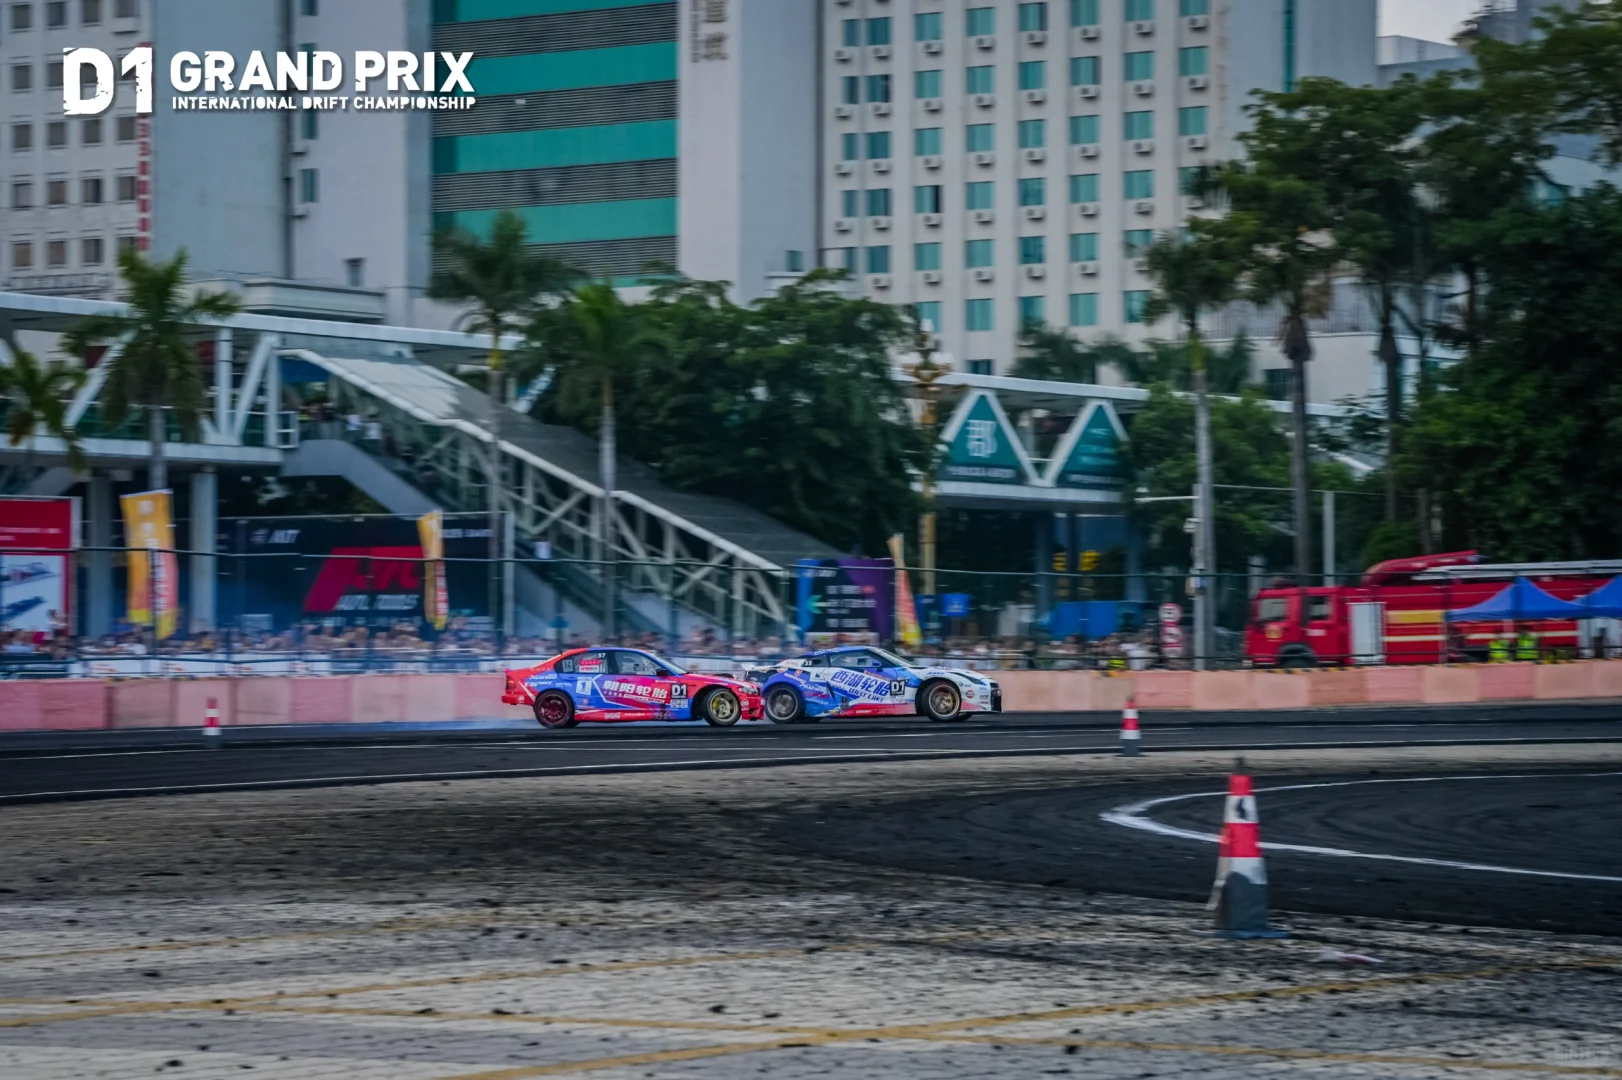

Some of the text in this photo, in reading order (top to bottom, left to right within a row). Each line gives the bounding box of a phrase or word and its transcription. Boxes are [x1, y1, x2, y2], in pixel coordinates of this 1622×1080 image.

[831, 669, 891, 697] 西湖轮胎
[891, 681, 906, 693] D1
[672, 684, 687, 696] D1
